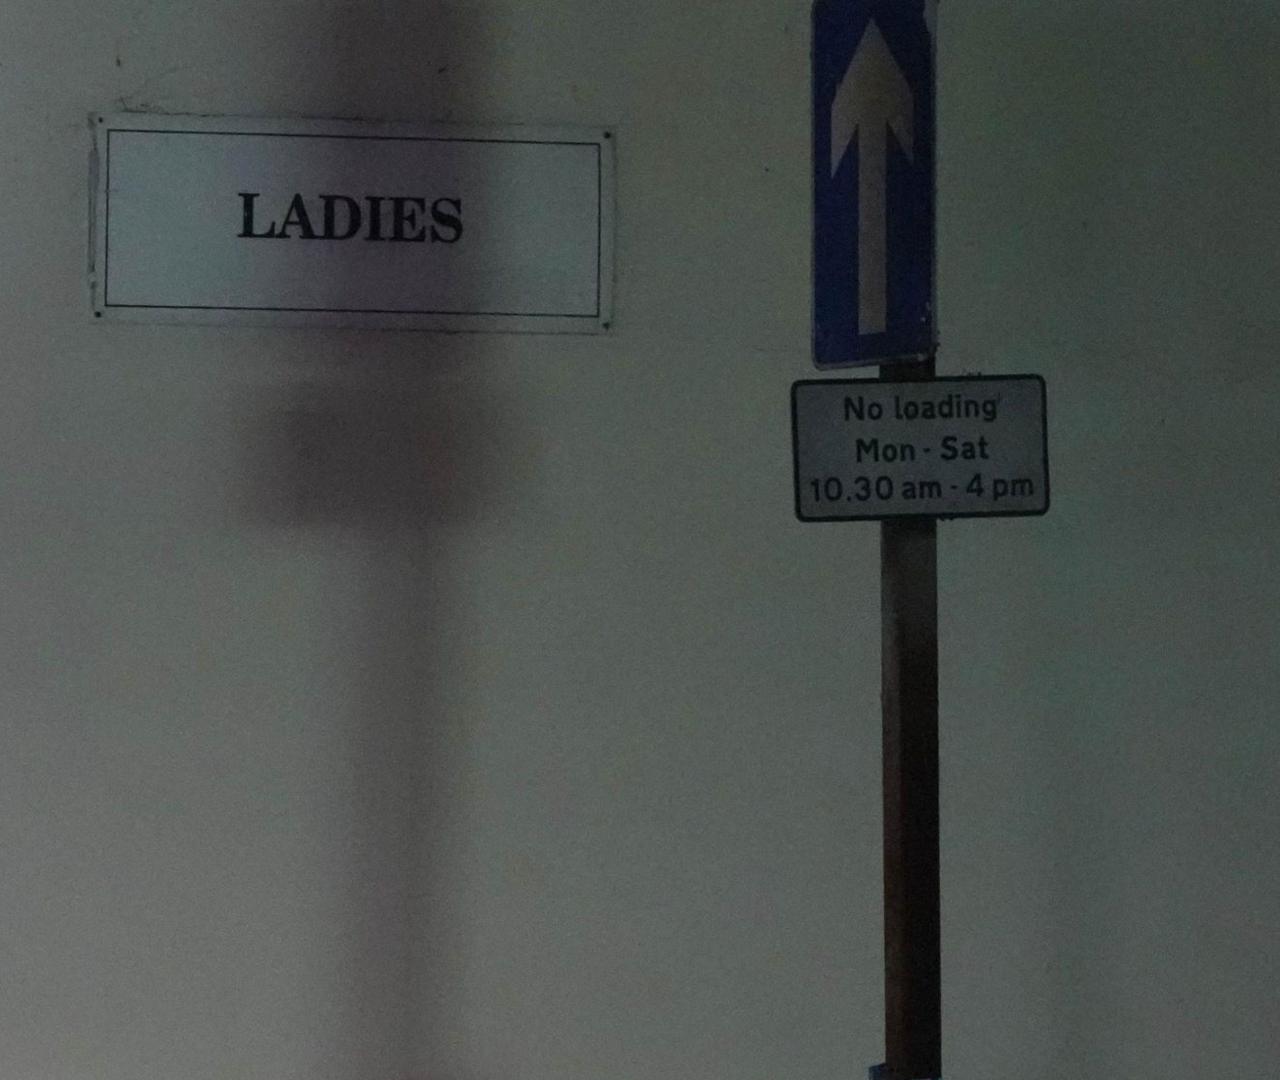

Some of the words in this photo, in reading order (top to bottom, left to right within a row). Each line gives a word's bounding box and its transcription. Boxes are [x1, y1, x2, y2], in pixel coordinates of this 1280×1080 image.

[237, 192, 464, 243] LADIES
[844, 397, 883, 420] No
[894, 394, 997, 421] loading
[856, 438, 915, 462] Mon
[940, 436, 990, 460] Sat
[810, 476, 893, 501] 10.30
[902, 484, 942, 499] am
[966, 473, 984, 496] 4
[993, 478, 1034, 500] pm
